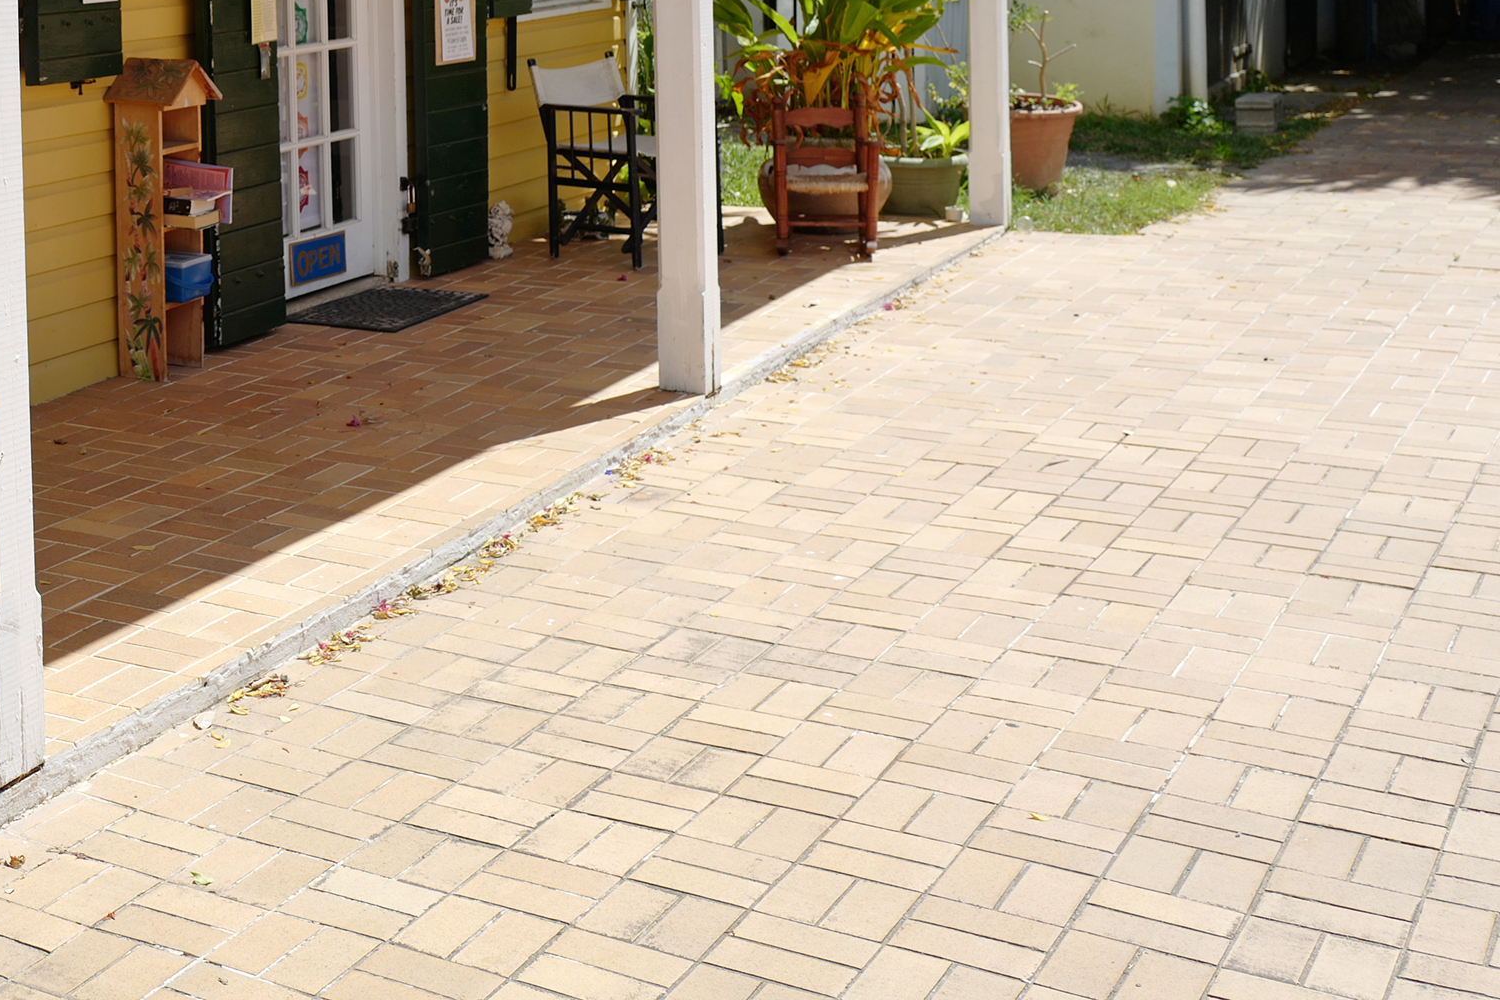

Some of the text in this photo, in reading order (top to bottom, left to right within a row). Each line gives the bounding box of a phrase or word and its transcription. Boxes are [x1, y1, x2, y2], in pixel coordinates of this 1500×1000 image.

[450, 0, 458, 7] IT'S
[445, 6, 464, 16] TIME FOR
[447, 15, 463, 25] A SALE!
[297, 243, 340, 276] OPEN
